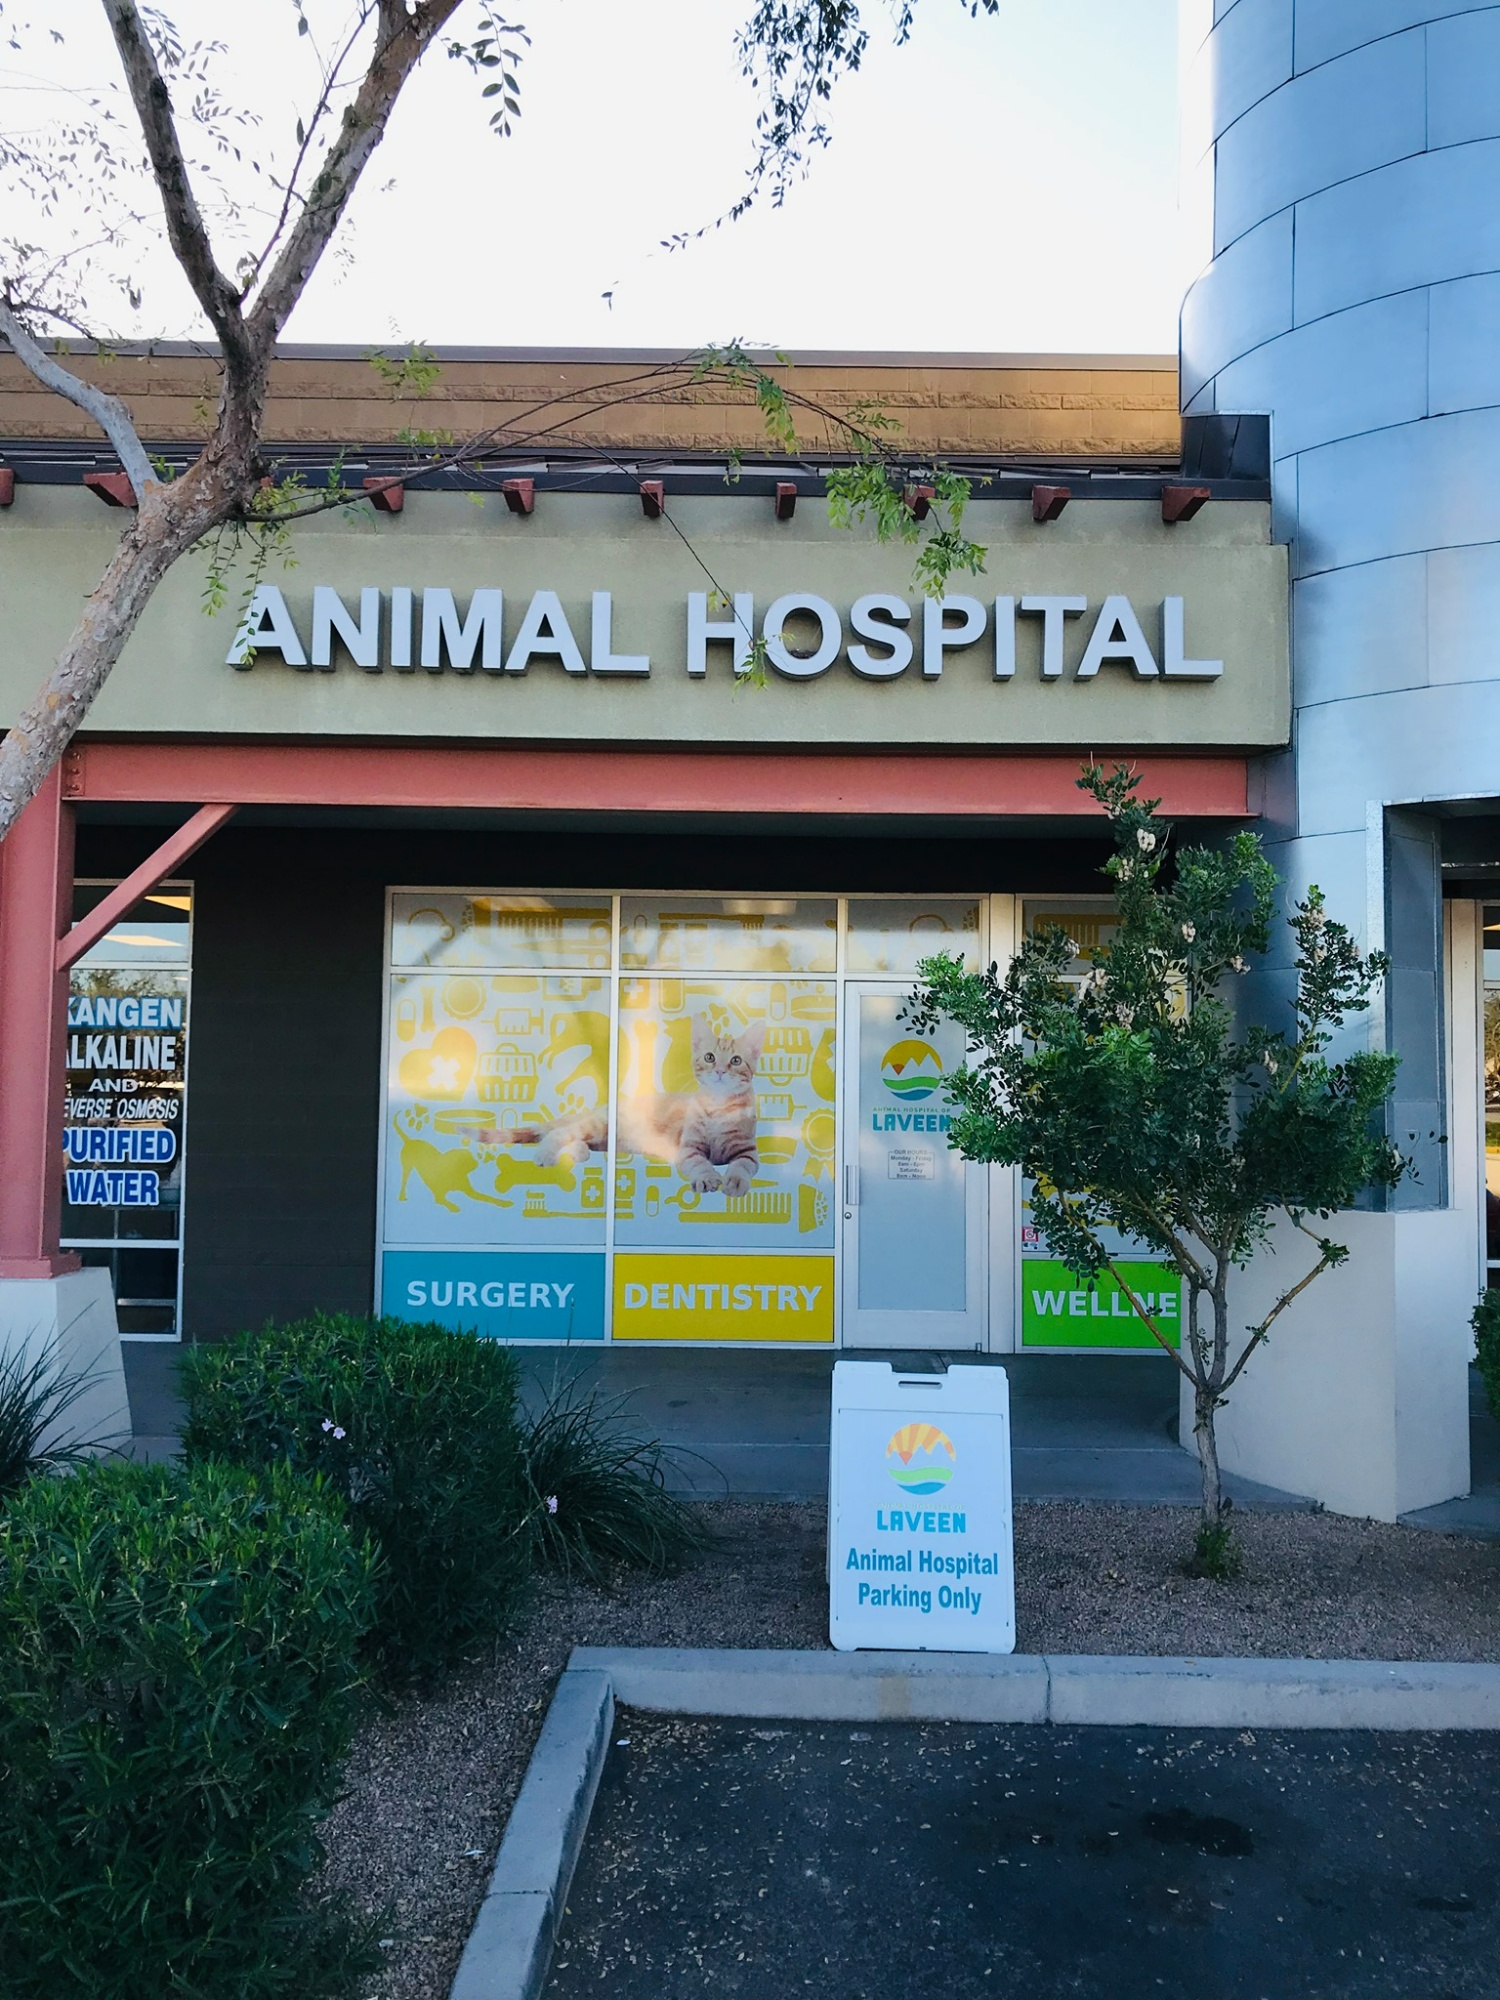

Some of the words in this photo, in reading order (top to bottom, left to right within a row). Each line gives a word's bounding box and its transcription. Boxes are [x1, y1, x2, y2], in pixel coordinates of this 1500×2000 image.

[225, 584, 650, 676] ANIMAL
[687, 591, 1223, 680] HOSPITAL
[66, 1034, 177, 1070] LKALINE
[88, 1078, 139, 1092] AND
[117, 1098, 180, 1119] OSMOSIS
[872, 1113, 952, 1132] LAVEEN
[66, 1169, 159, 1205] WATER
[407, 1280, 575, 1308] SURGERY
[624, 1283, 822, 1311] DENTISTRY
[877, 1510, 966, 1534] LAVEEN
[846, 1547, 912, 1572] Animal
[919, 1550, 998, 1579] Hospital
[858, 1582, 932, 1614] Parking
[938, 1585, 982, 1615] Only
